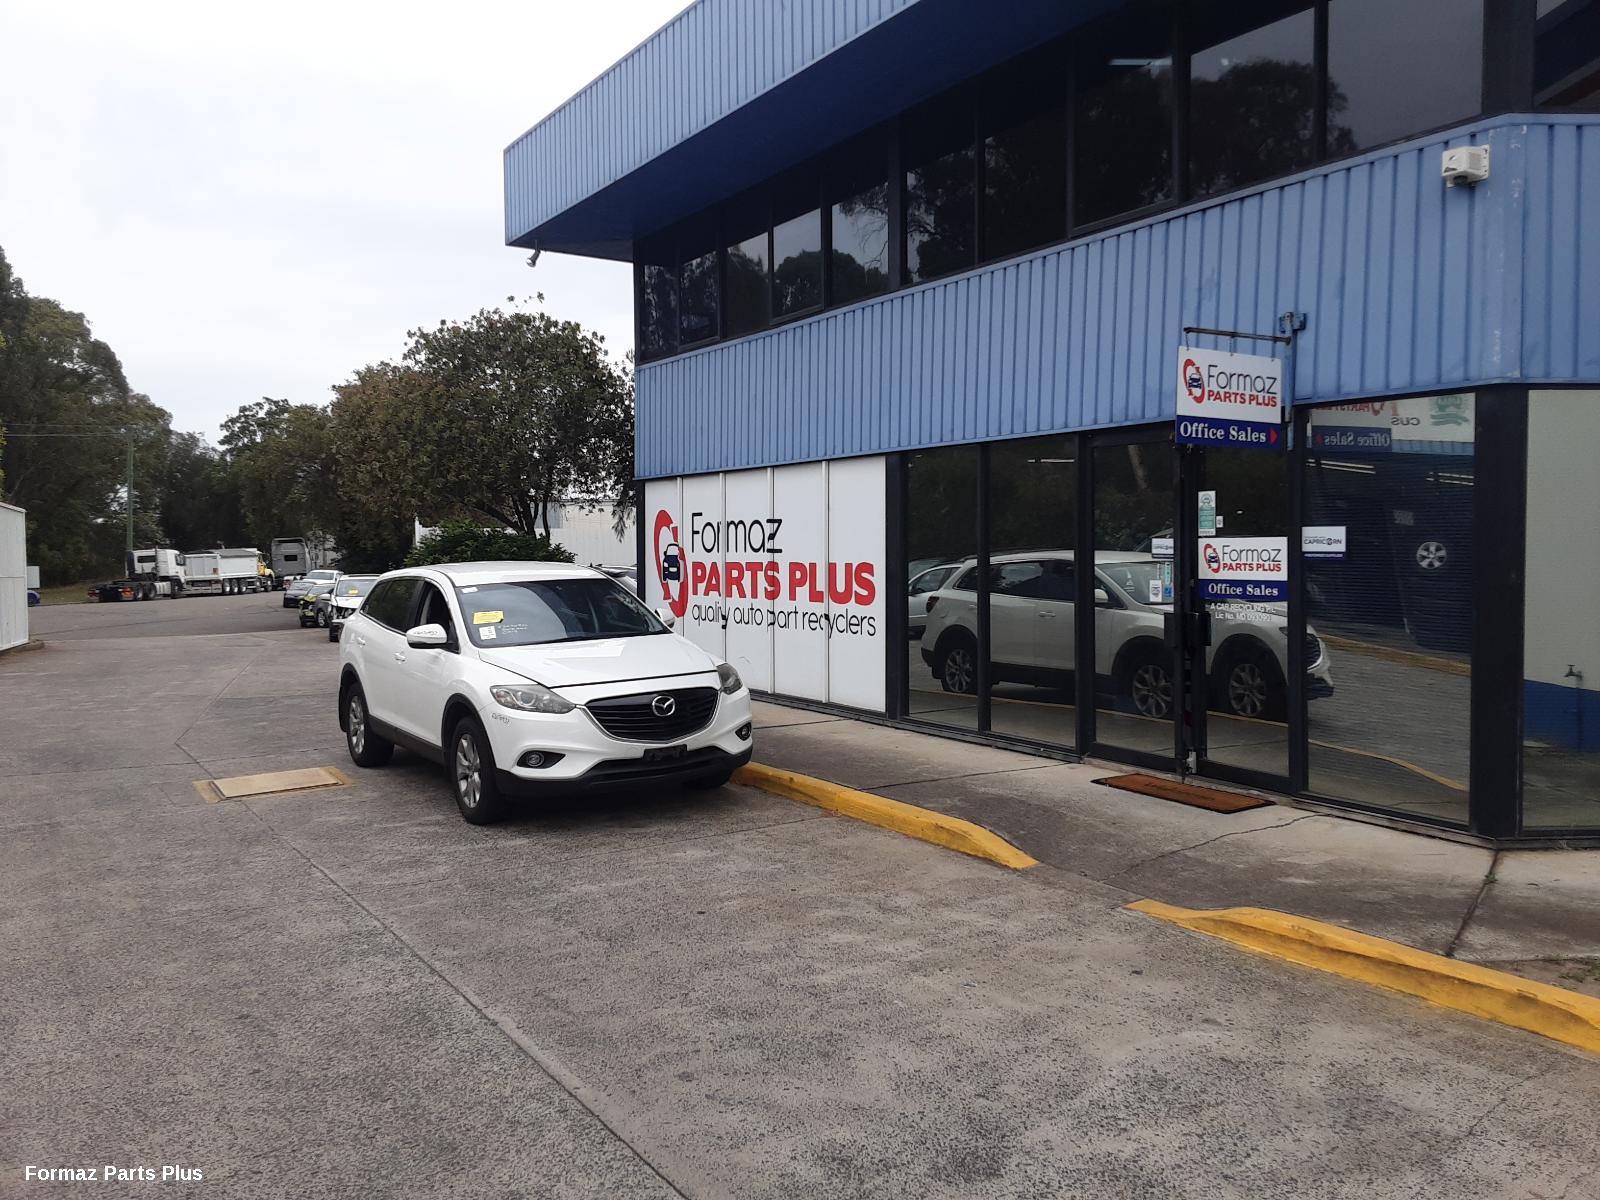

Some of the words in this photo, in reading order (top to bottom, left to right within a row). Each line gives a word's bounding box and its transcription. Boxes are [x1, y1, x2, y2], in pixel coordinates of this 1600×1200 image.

[1208, 364, 1277, 395] Formaz
[1207, 390, 1246, 404] PARTS
[1249, 394, 1277, 407] PLUS
[1180, 421, 1225, 439] Office
[1229, 425, 1266, 442] Sales
[691, 512, 782, 554] Formaz
[1222, 544, 1282, 563] Formaz
[1222, 563, 1254, 572] PARTS
[1256, 563, 1282, 572] PLUS
[691, 561, 781, 601] PARTS
[788, 561, 876, 606] PLUS
[1208, 583, 1243, 595] Office
[1246, 584, 1279, 596] Sales
[692, 601, 730, 630] qualiy
[733, 603, 763, 626] auto
[767, 605, 799, 633] part
[802, 608, 877, 639] recyclers
